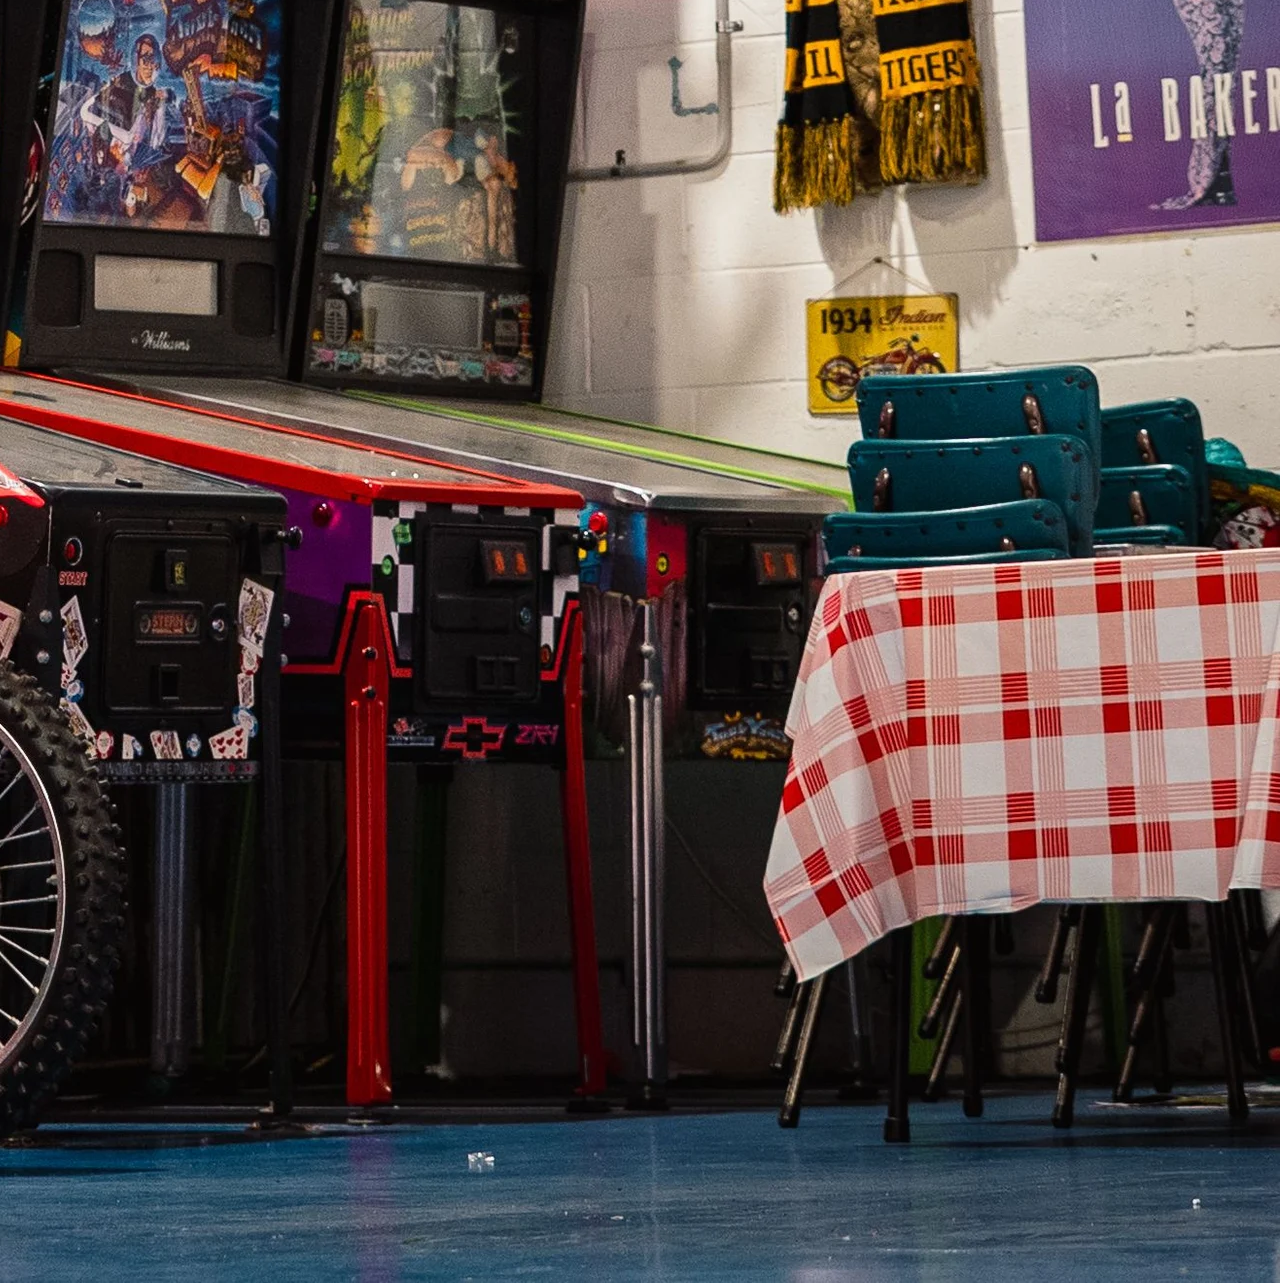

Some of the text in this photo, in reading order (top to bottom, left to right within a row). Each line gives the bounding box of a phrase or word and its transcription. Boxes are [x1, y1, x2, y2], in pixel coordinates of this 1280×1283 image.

[820, 304, 947, 335] 1934 Indian
[58, 571, 89, 586] START
